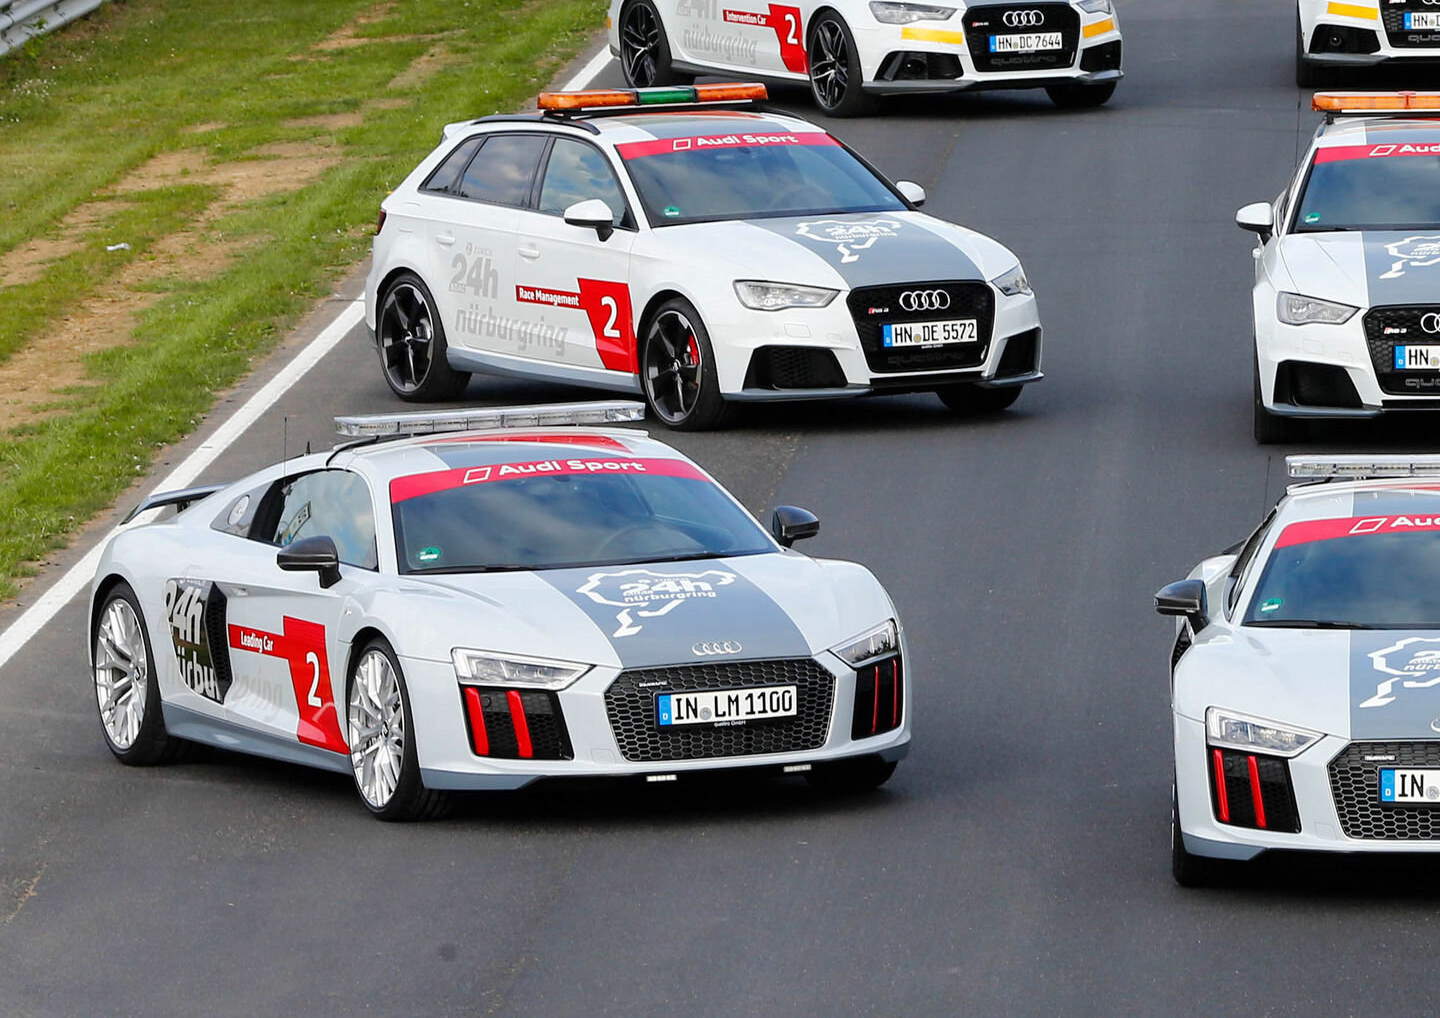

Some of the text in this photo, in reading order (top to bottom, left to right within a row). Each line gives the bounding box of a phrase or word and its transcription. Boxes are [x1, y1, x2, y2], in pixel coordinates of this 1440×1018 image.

[726, 11, 767, 25] Intervention Car
[1413, 14, 1428, 27] HN
[784, 13, 799, 45] 2
[998, 35, 1060, 50] HN DC 7644
[696, 134, 799, 147] Audi Sport
[448, 253, 499, 299] 24h
[519, 287, 580, 306] Race Management
[601, 295, 621, 338] 2
[455, 303, 569, 357] nürburgring
[894, 322, 976, 344] HN DE 5572
[1408, 349, 1429, 365] HN
[499, 457, 646, 476] Audi Sport
[619, 580, 713, 597] 24h
[624, 591, 717, 603] nürburgring
[240, 630, 274, 653] Leading Car
[306, 651, 322, 707] 2
[663, 690, 793, 721] D IN LM 1100
[1385, 788, 1391, 796] D
[1398, 774, 1424, 798] IN
